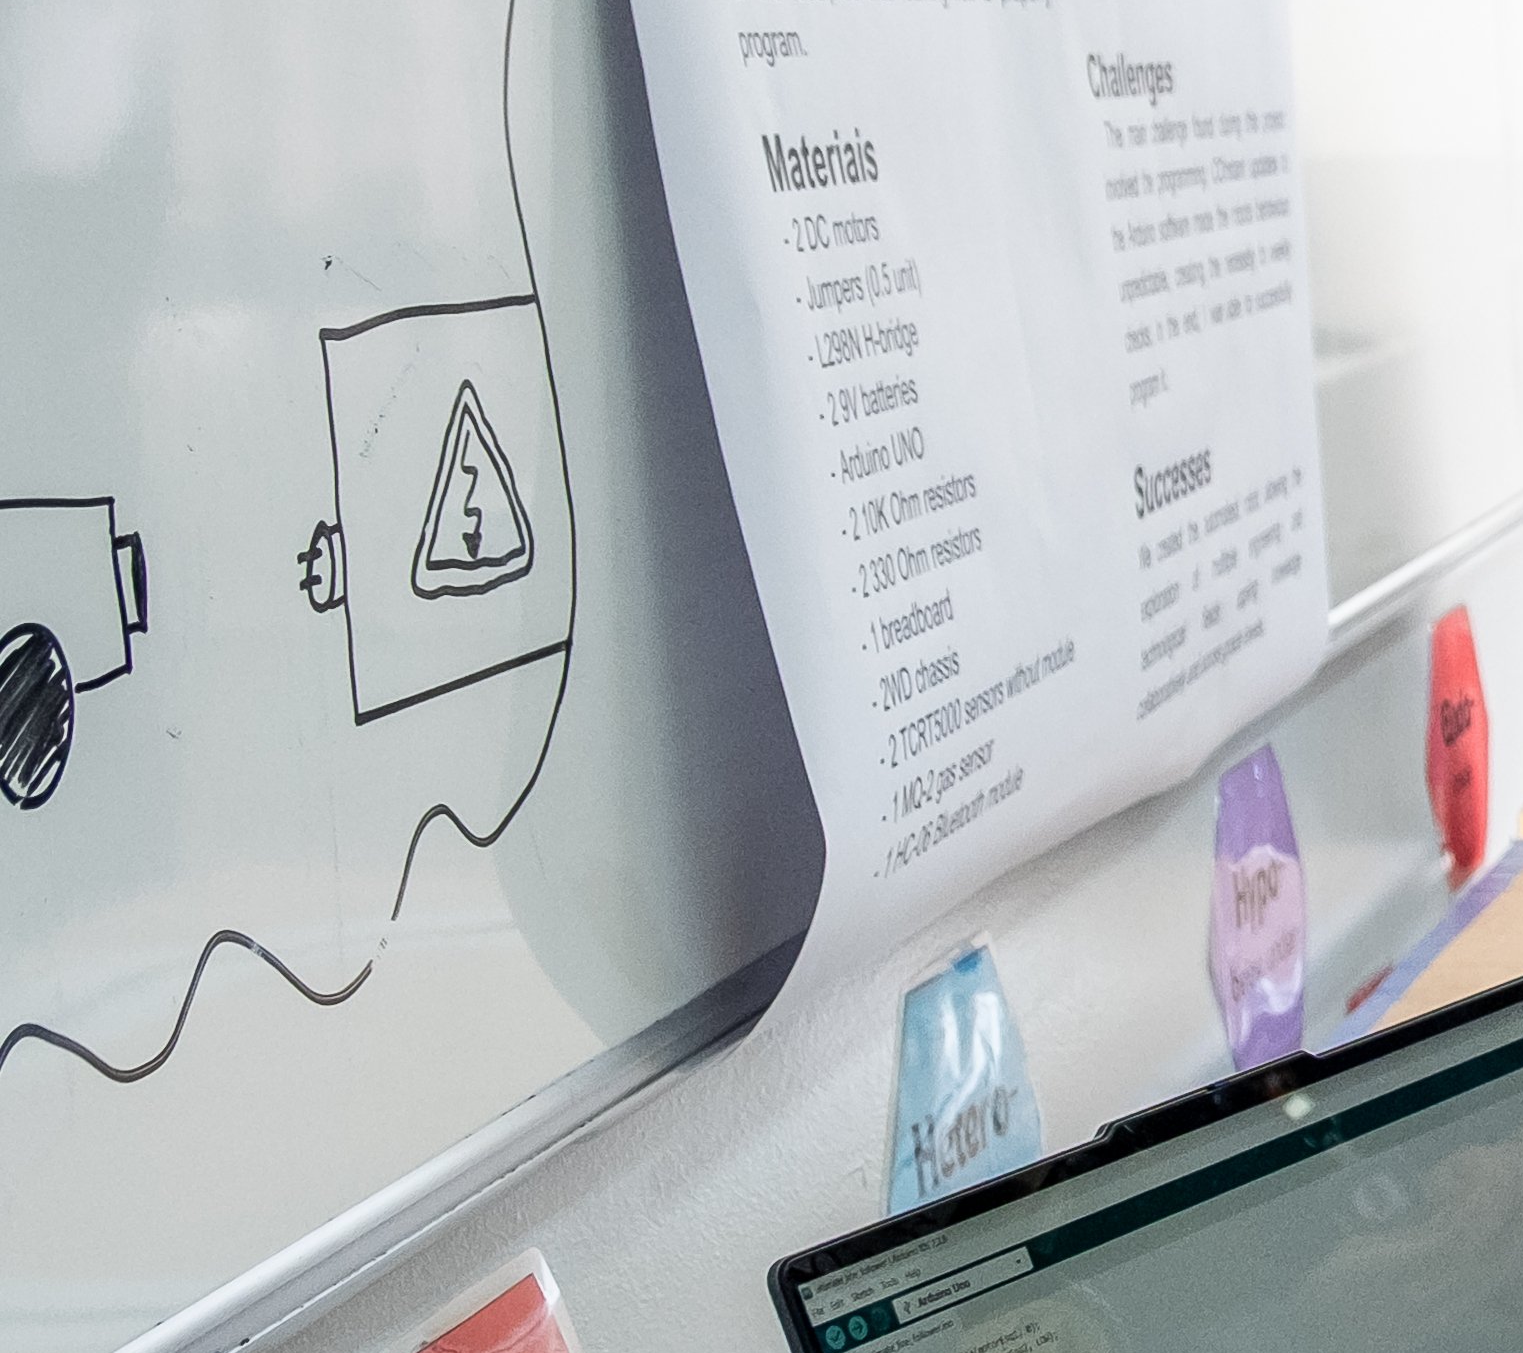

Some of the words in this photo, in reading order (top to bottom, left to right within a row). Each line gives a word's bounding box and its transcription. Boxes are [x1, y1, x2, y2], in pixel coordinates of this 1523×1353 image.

[738, 30, 808, 68] program.
[1086, 51, 1173, 107] Challenges
[792, 217, 805, 252] 2
[804, 214, 830, 251] DC
[832, 212, 880, 247] motors
[806, 275, 865, 314] Jumpers
[815, 325, 864, 368] L298N
[861, 317, 919, 357] H-bridge
[827, 392, 839, 426] 2
[840, 386, 858, 423] 9V
[859, 375, 919, 417] batteries
[840, 441, 891, 484] Arduino
[890, 426, 925, 467] UNO
[1133, 447, 1212, 520] Successes
[850, 507, 861, 541] 2
[861, 495, 890, 536] 10K
[890, 490, 923, 525] Ohm
[923, 472, 978, 514] resistors
[858, 563, 870, 598] 2
[869, 553, 897, 593] 330
[897, 545, 931, 581] Ohm
[930, 526, 983, 569] resistors
[870, 621, 880, 653] 1
[879, 587, 954, 650] breadboard
[879, 666, 913, 712] 2WD
[914, 645, 960, 694] chassis
[888, 734, 899, 768] 2
[899, 698, 962, 761] TCRT5000
[964, 681, 1004, 725] sensors
[1006, 652, 1040, 698] without
[892, 790, 899, 823] 1
[901, 769, 935, 818] MQ-2
[935, 762, 957, 804] gas
[959, 738, 995, 781] sensor
[884, 847, 893, 878] 1
[893, 820, 933, 873] HC-06
[917, 1287, 952, 1308] Arduino
